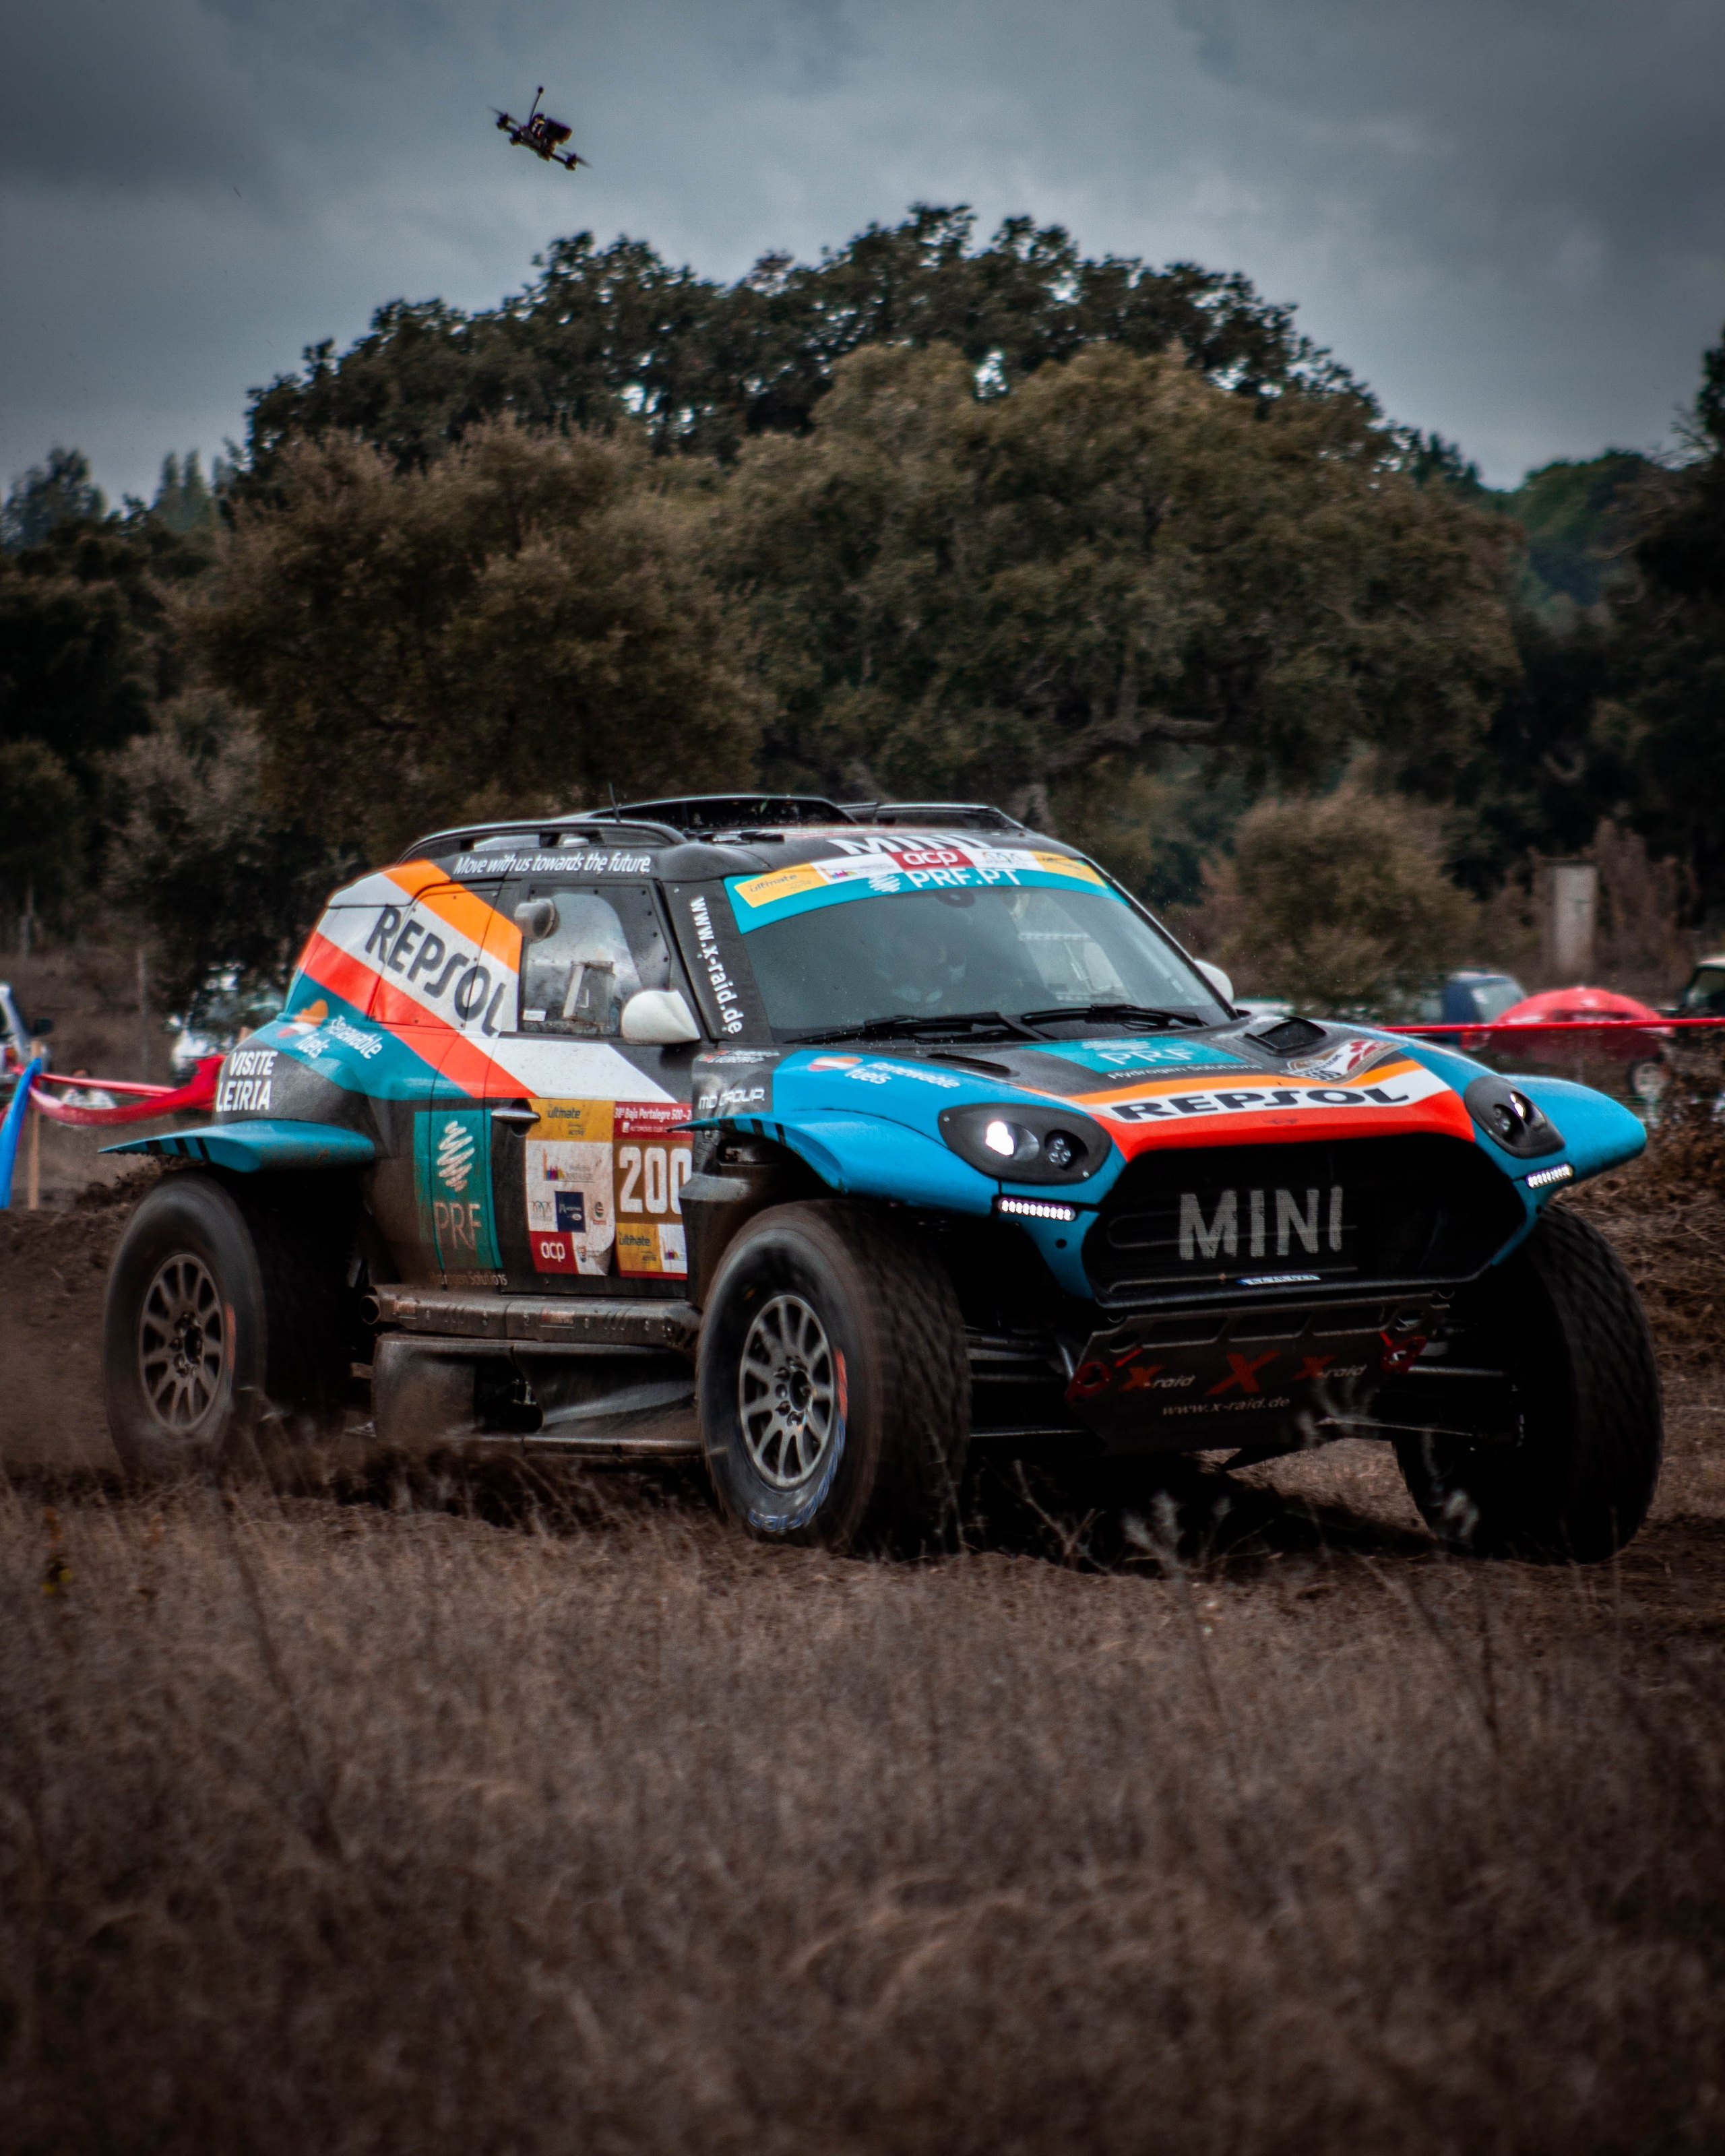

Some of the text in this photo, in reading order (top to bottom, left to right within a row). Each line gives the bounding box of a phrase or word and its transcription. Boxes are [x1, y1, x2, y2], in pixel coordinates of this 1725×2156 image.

[453, 852, 652, 875] Move with us towards the future.
[903, 850, 959, 866] acp
[906, 868, 1022, 889] PRF.PT
[365, 905, 507, 1038] REPSOL
[690, 895, 745, 1034] www.x-raid.de
[228, 1051, 278, 1077] VISITE
[1098, 1048, 1195, 1065] PRF
[215, 1080, 272, 1112] LEIRIA
[1110, 1087, 1410, 1121] REPSOL
[619, 1146, 693, 1215] 200
[433, 1201, 482, 1250] PRF
[1179, 1184, 1344, 1261] MINI
[541, 1241, 566, 1263] acp
[1162, 1395, 1290, 1416] www.x-raid.de
